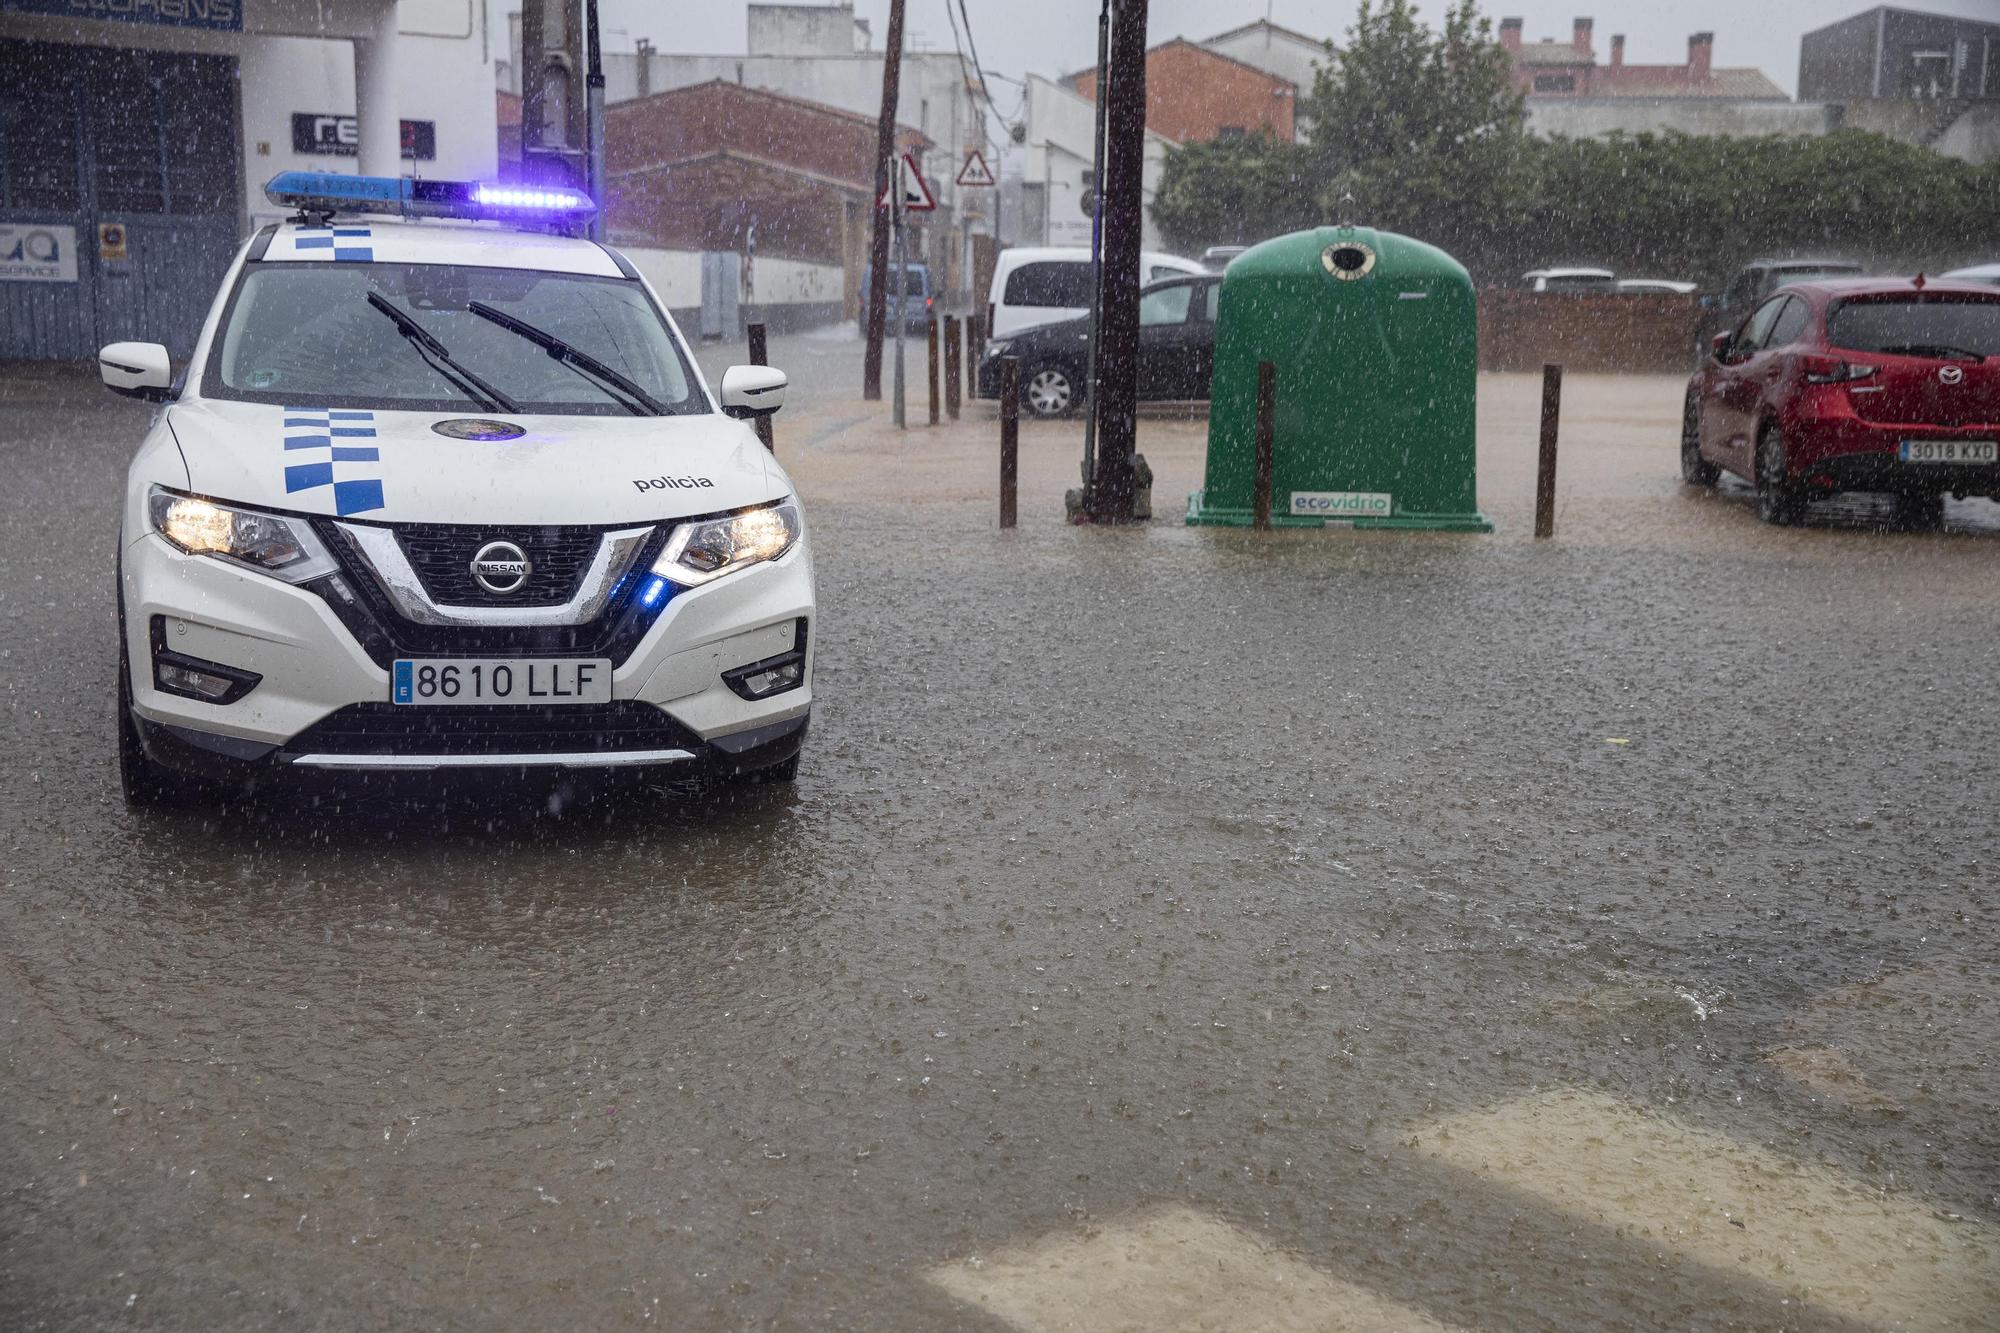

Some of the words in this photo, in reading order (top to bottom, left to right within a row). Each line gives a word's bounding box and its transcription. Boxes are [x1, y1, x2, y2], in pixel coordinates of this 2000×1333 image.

[1912, 443, 1956, 459] 3018
[632, 475, 715, 493] policia
[1295, 493, 1387, 510] ecovidrio
[476, 564, 526, 572] NISSAN
[400, 686, 408, 697] E
[417, 665, 513, 698] 8610
[528, 664, 597, 697] LLF
